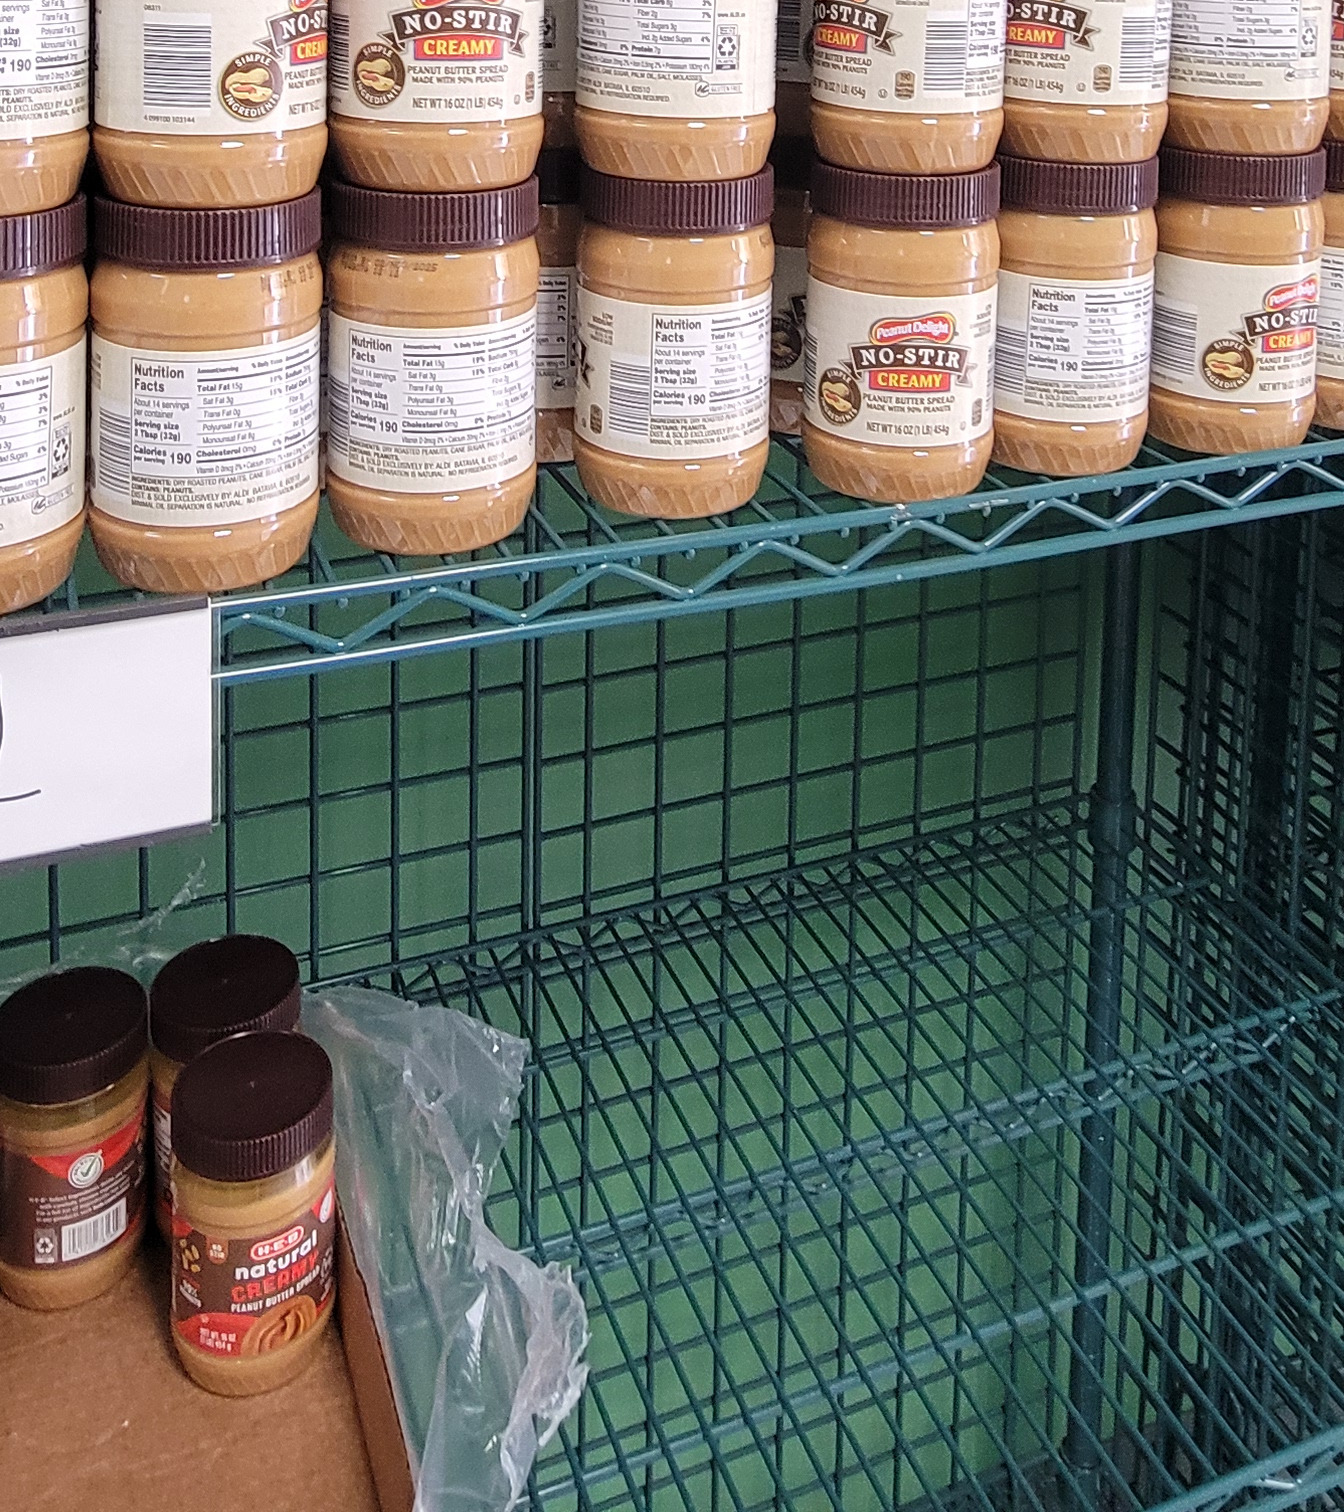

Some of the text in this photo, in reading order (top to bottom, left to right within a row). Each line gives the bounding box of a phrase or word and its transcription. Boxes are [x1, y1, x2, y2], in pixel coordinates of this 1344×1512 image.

[402, 11, 512, 35] NO-STIR
[1009, 28, 1055, 44] REAMY
[363, 45, 393, 57] SIMPLE
[424, 40, 494, 55] CREAMY
[10, 59, 31, 71] 190
[235, 54, 272, 67] SIMPLE
[408, 65, 508, 75] PEANUT BUTTER SPREAD
[225, 94, 279, 117] INGREDIENTS
[413, 98, 441, 108] NET WT
[1032, 288, 1075, 302] Nutrition
[656, 319, 701, 330] Nutrition
[877, 322, 949, 339] Peanut Delight
[351, 336, 392, 352] Nutrition
[656, 332, 684, 343] Facts
[861, 348, 960, 368] NO-STIR
[134, 364, 184, 379] Nutrition
[1060, 360, 1077, 372] 190
[134, 379, 165, 392] Facts
[878, 373, 942, 387] CREAMY
[688, 394, 705, 404] 190
[379, 421, 398, 432] 190
[134, 445, 191, 464] Calories 190
[235, 1229, 317, 1280] natural
[231, 1249, 319, 1302] CREAMY
[231, 1300, 263, 1313] PEANUT
[266, 1287, 294, 1307] BUTTER
